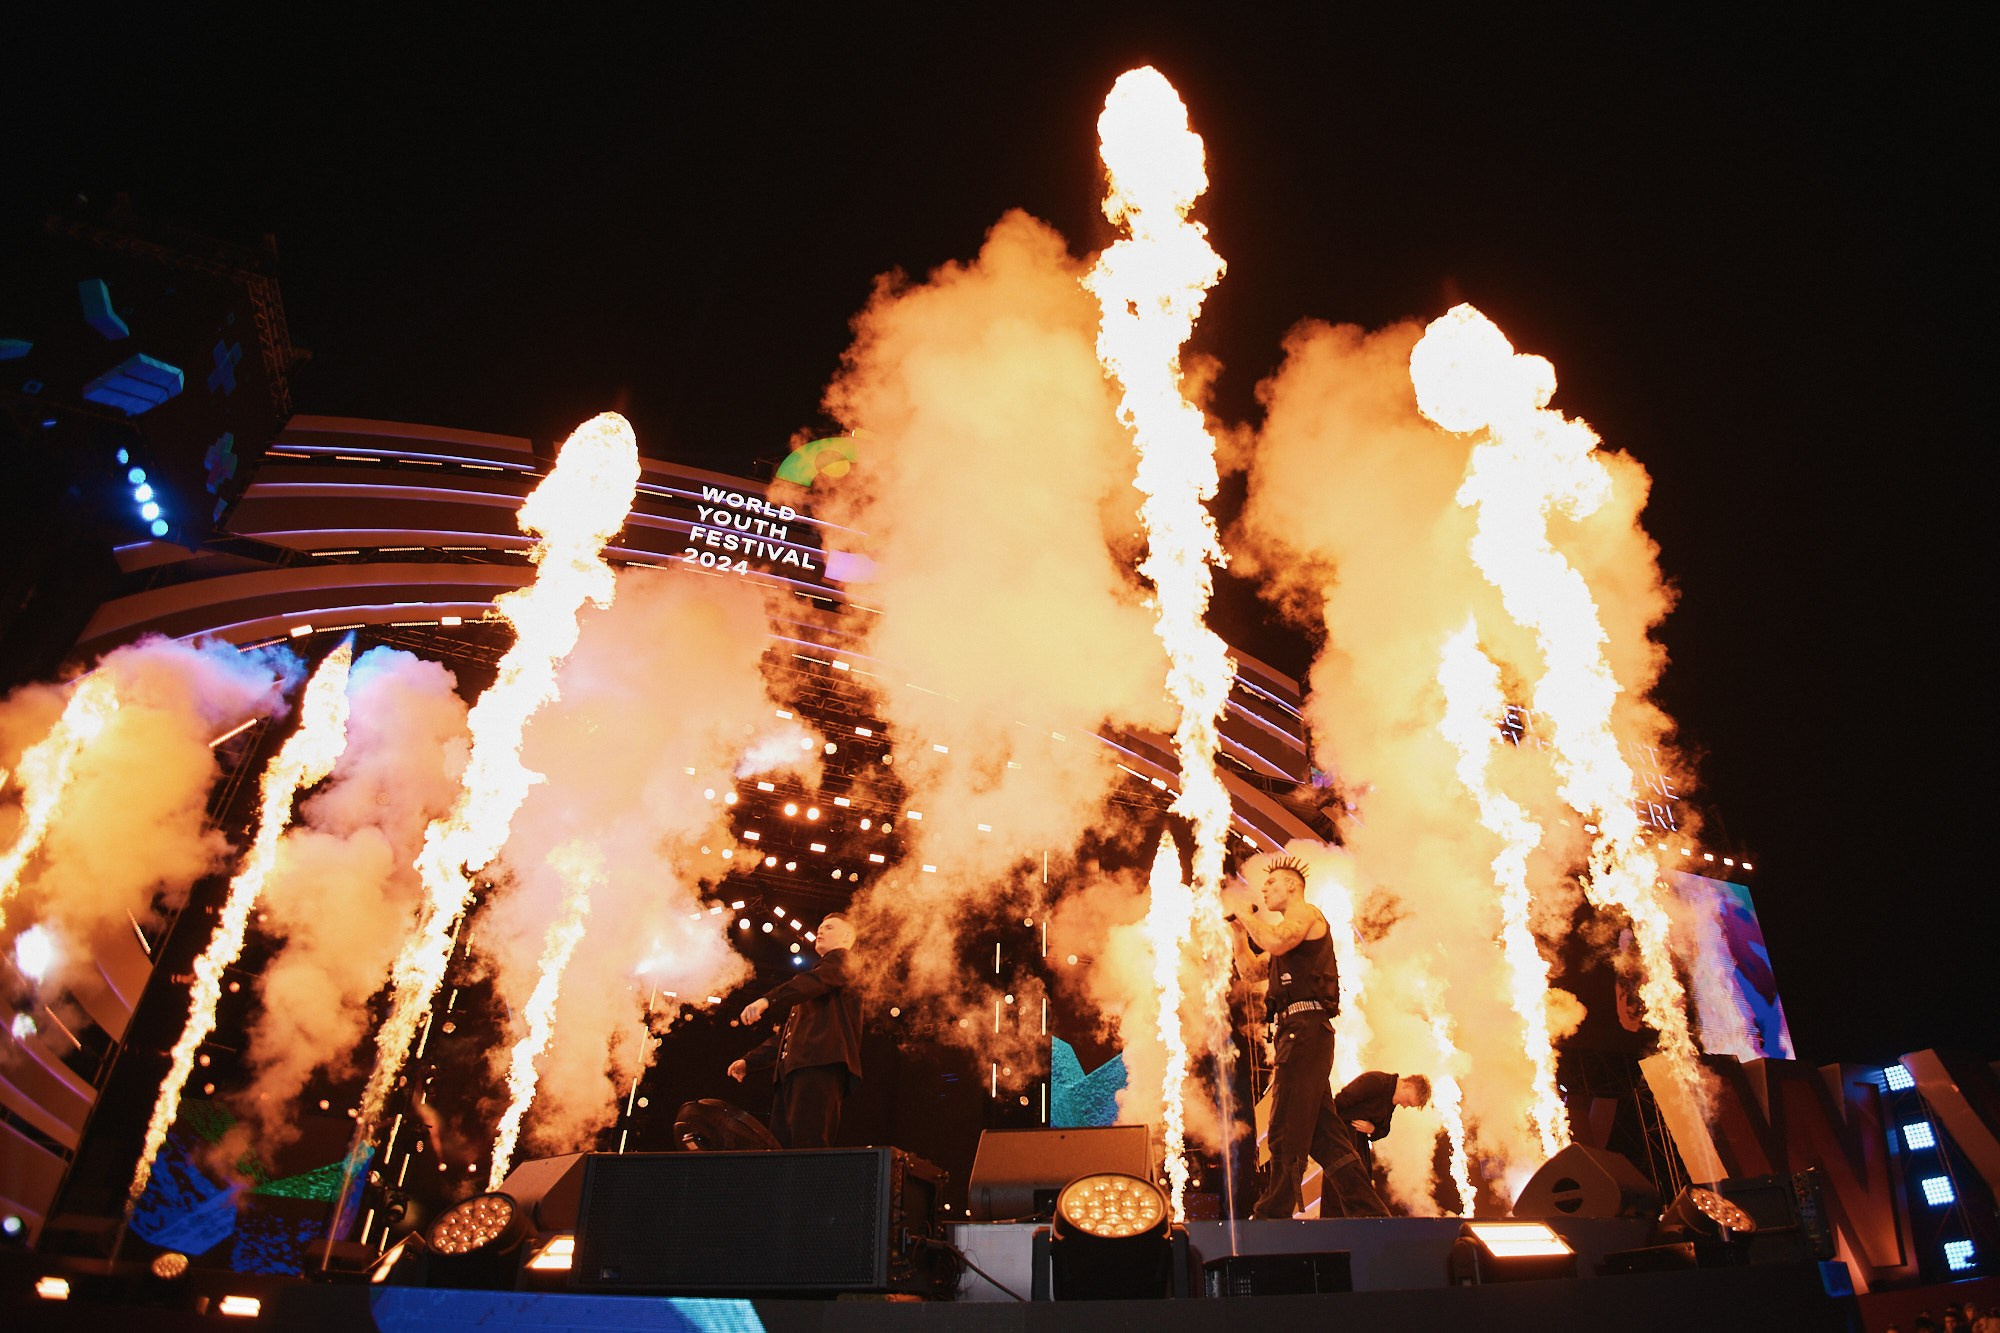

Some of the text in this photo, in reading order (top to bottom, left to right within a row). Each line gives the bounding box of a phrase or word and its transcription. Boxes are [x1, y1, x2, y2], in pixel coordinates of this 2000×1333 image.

[702, 485, 796, 522] WORLD
[697, 504, 788, 541] YOUTH
[682, 547, 749, 576] 2024
[689, 525, 816, 571] FESTIVAL
